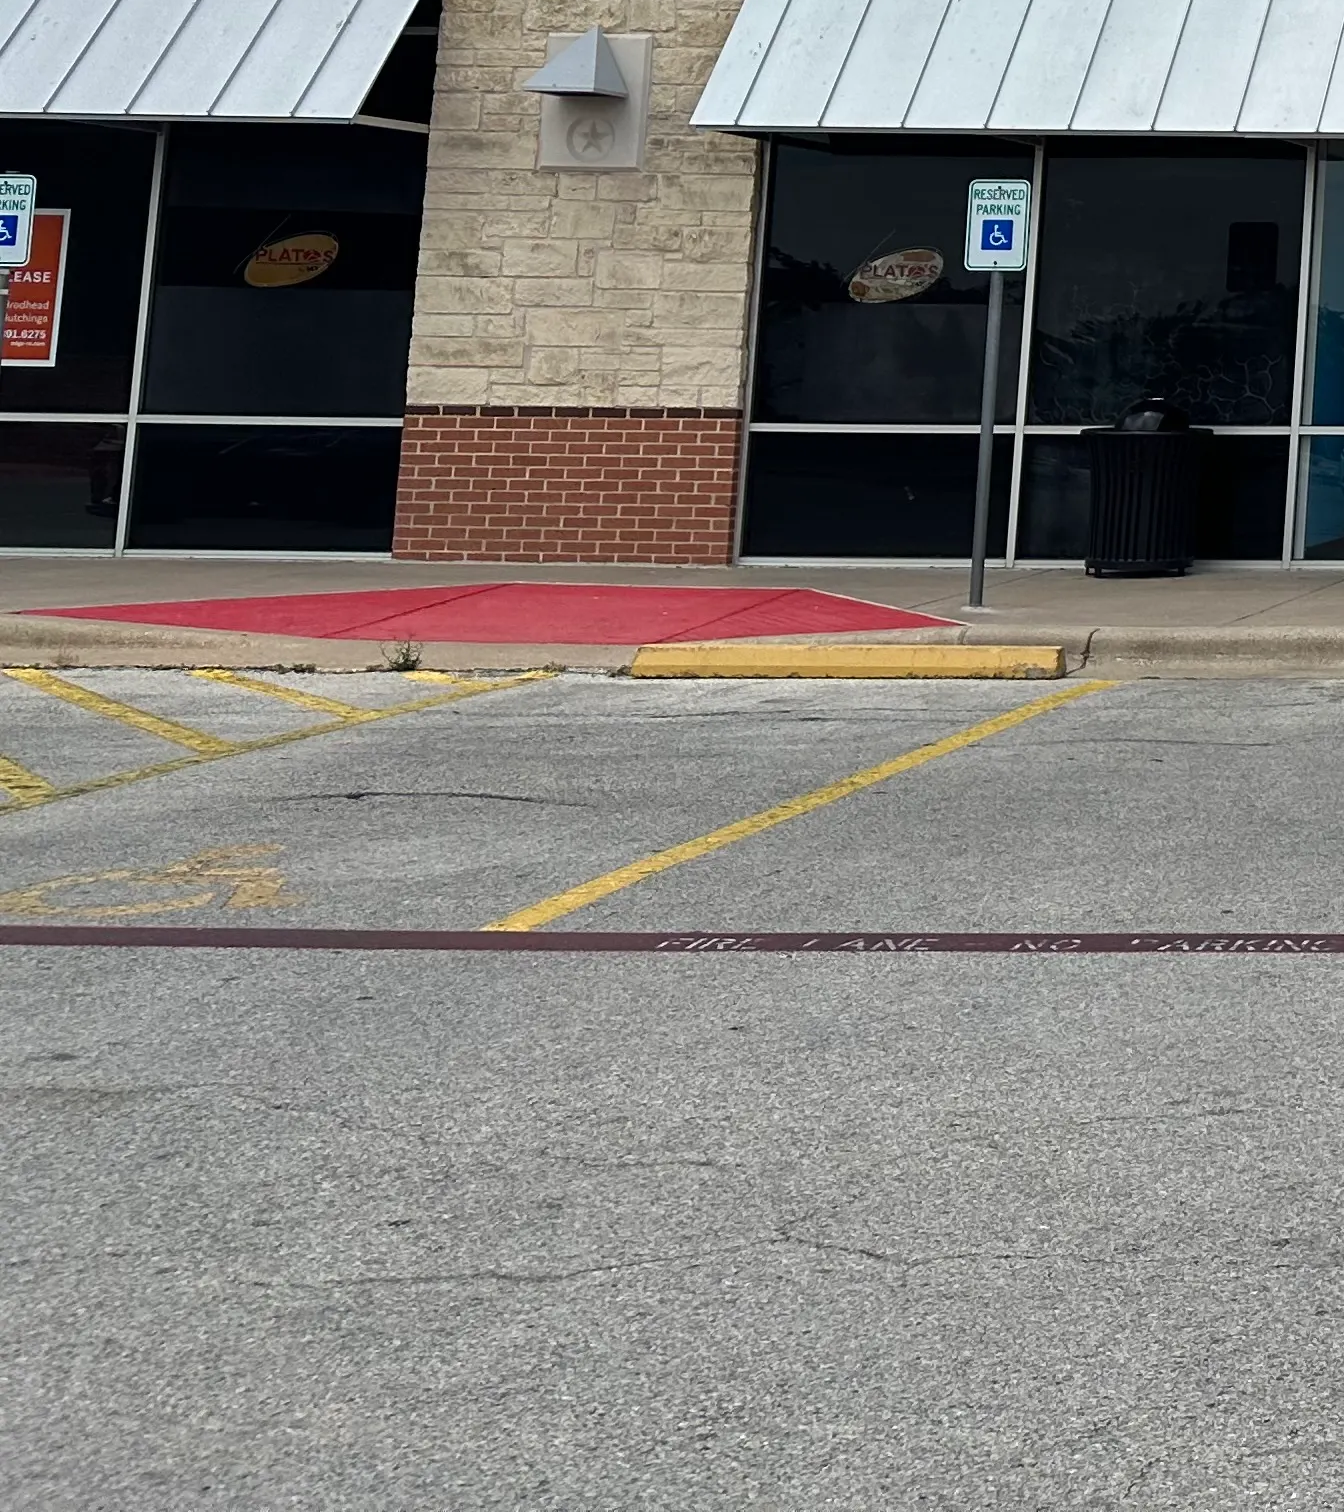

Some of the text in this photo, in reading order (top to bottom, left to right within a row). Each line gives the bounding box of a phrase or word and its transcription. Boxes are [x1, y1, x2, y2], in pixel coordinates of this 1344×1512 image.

[973, 189, 1025, 201] RESERVED
[976, 204, 1021, 216] PARKING
[8, 271, 52, 283] EASE
